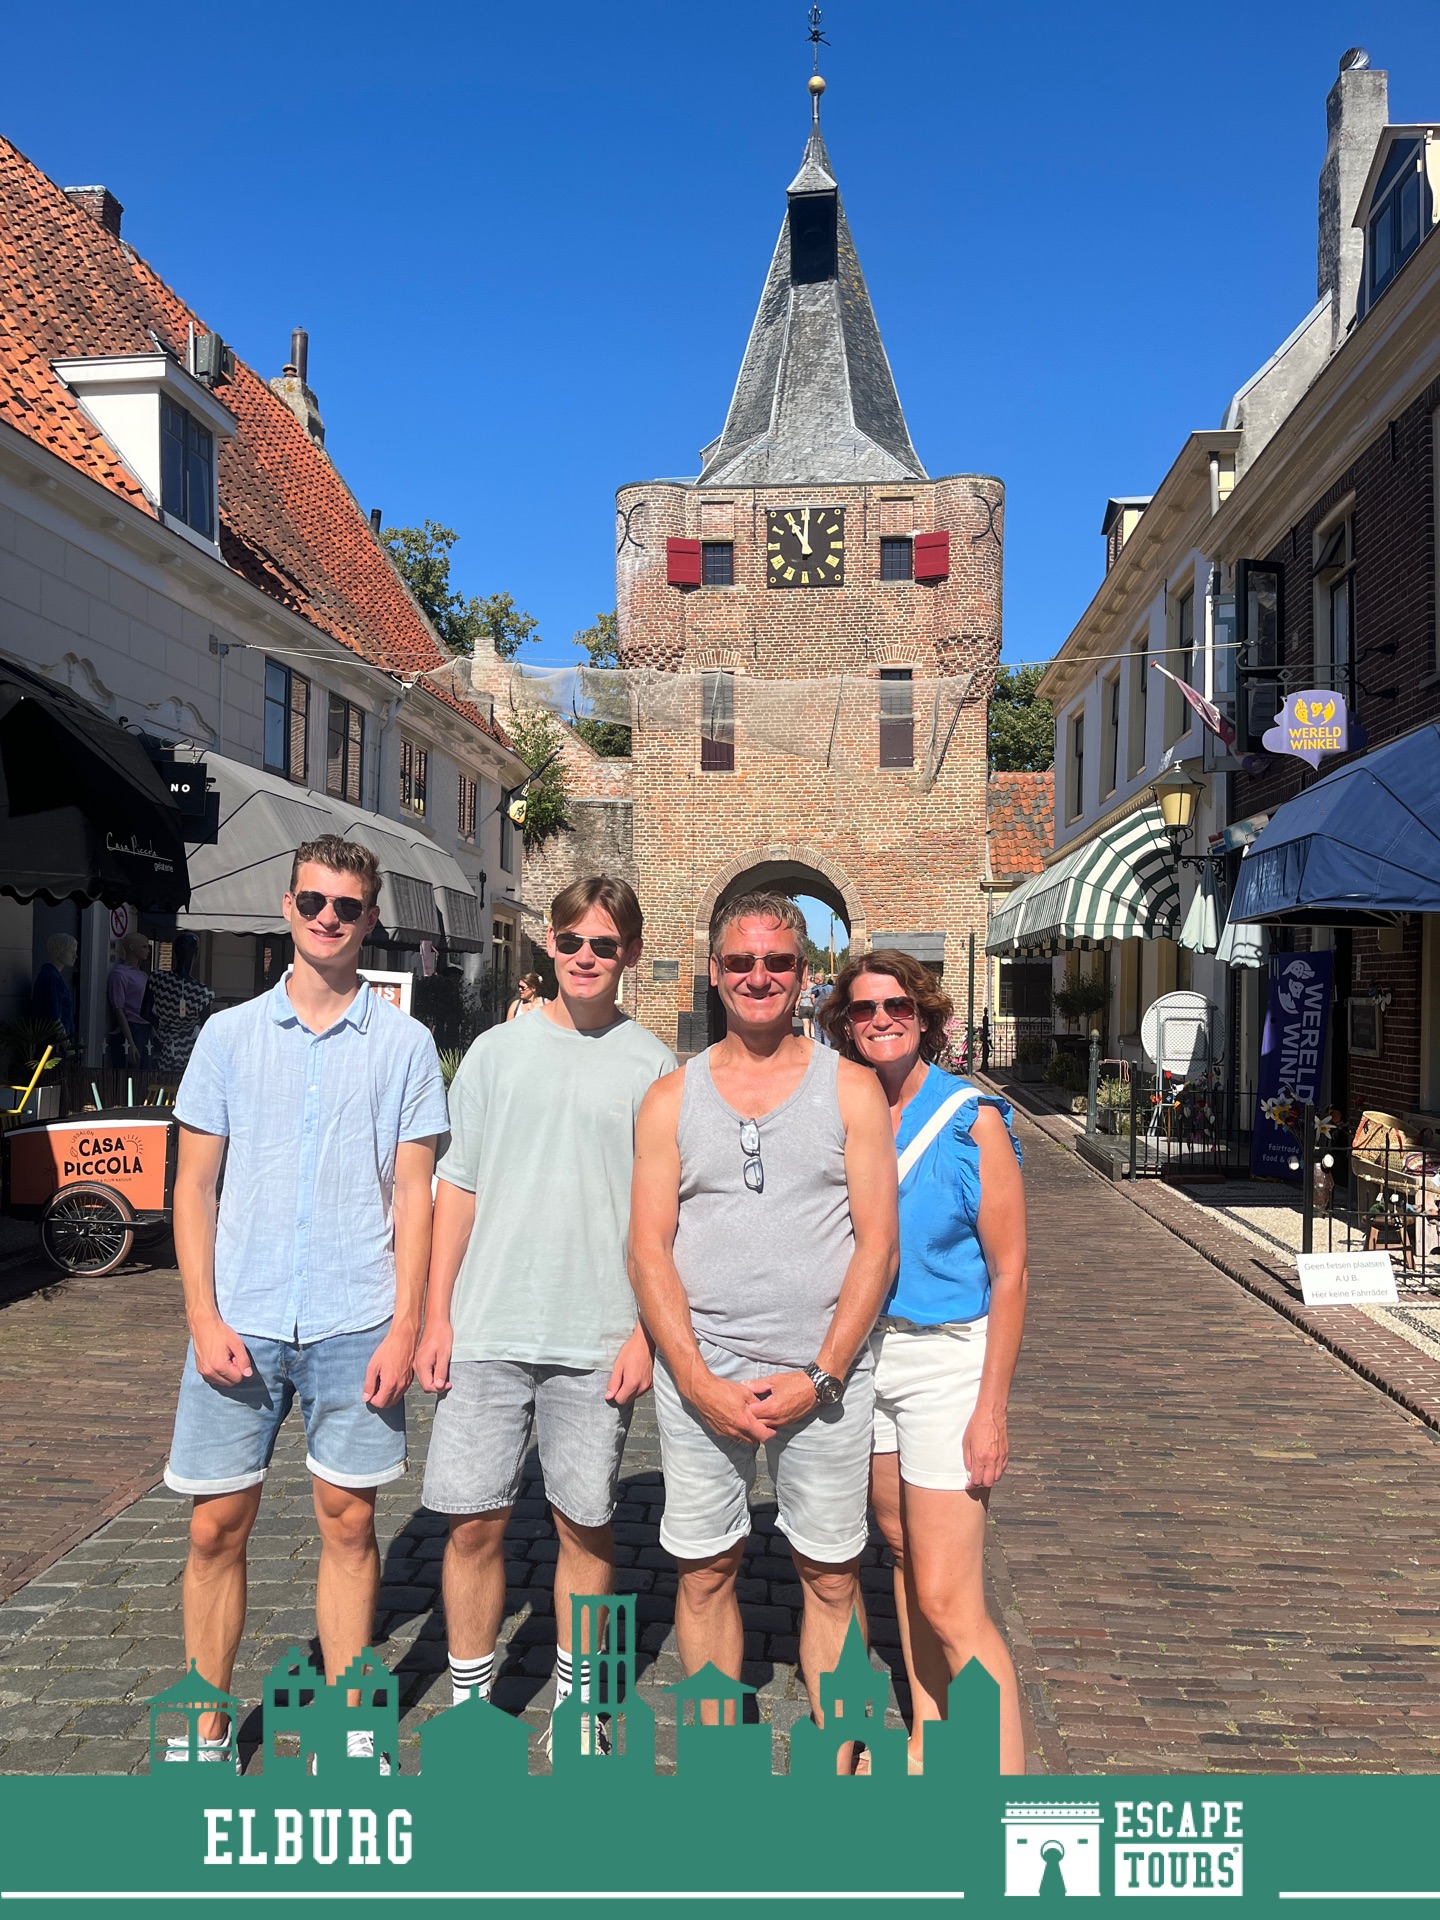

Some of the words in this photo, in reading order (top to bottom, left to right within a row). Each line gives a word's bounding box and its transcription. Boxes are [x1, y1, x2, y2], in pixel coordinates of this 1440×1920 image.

[1289, 726, 1341, 738] WERELD
[1290, 738, 1340, 750] WINKEL
[170, 783, 190, 793] NO
[1296, 982, 1324, 1104] WERELD
[78, 1137, 125, 1156] CASA
[1268, 1143, 1300, 1154] Fairtrade
[1262, 1153, 1278, 1162] Food
[64, 1156, 143, 1176] PICCOLA
[1326, 1261, 1351, 1270] fietsen
[1353, 1260, 1385, 1270] plaatsen
[1335, 1274, 1360, 1282] A.U.B.
[1311, 1291, 1328, 1299] Hier
[1328, 1289, 1350, 1298] keine
[1351, 1288, 1388, 1297] Fahrräder
